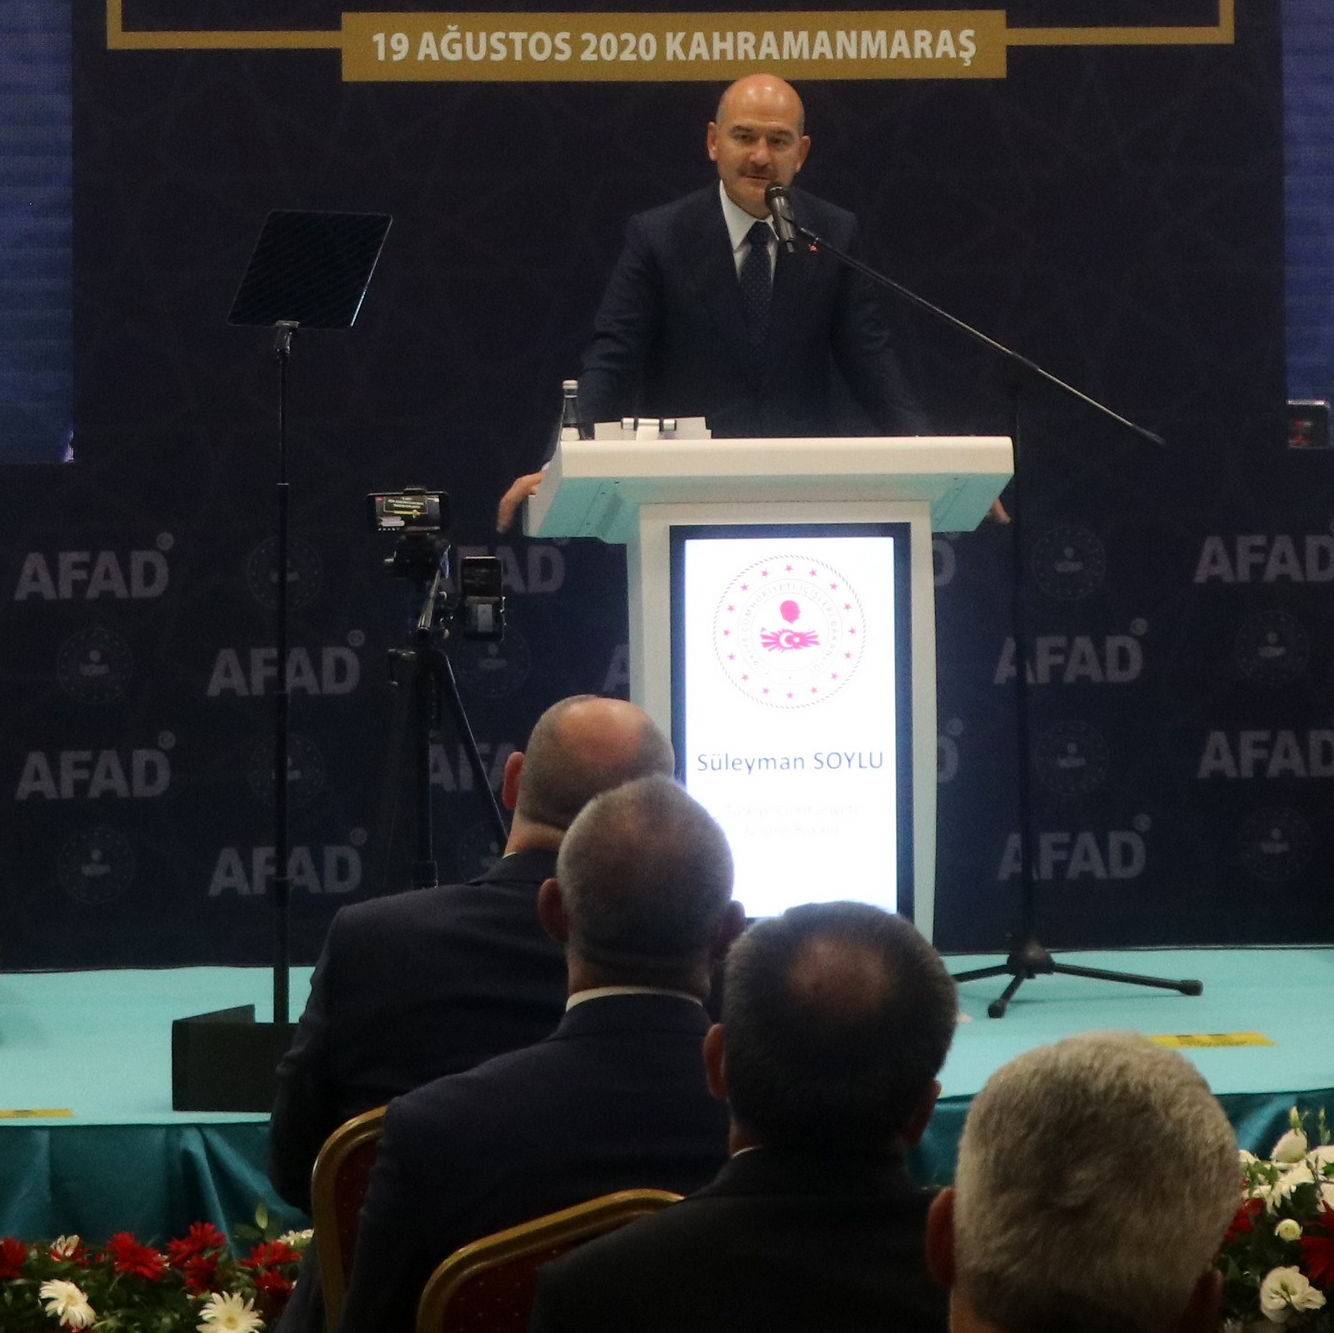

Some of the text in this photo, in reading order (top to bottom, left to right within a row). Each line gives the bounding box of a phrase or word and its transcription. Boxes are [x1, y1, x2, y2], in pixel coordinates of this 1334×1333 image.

[372, 26, 977, 66] 19 AĞUSTOS 2020 KAHRAMANMARAŞ
[15, 550, 169, 600] AFAD
[208, 646, 361, 697] AFAD
[16, 750, 171, 800] AFAD
[698, 752, 883, 774] Süleyman SOYLU
[208, 845, 362, 897] AFAD
